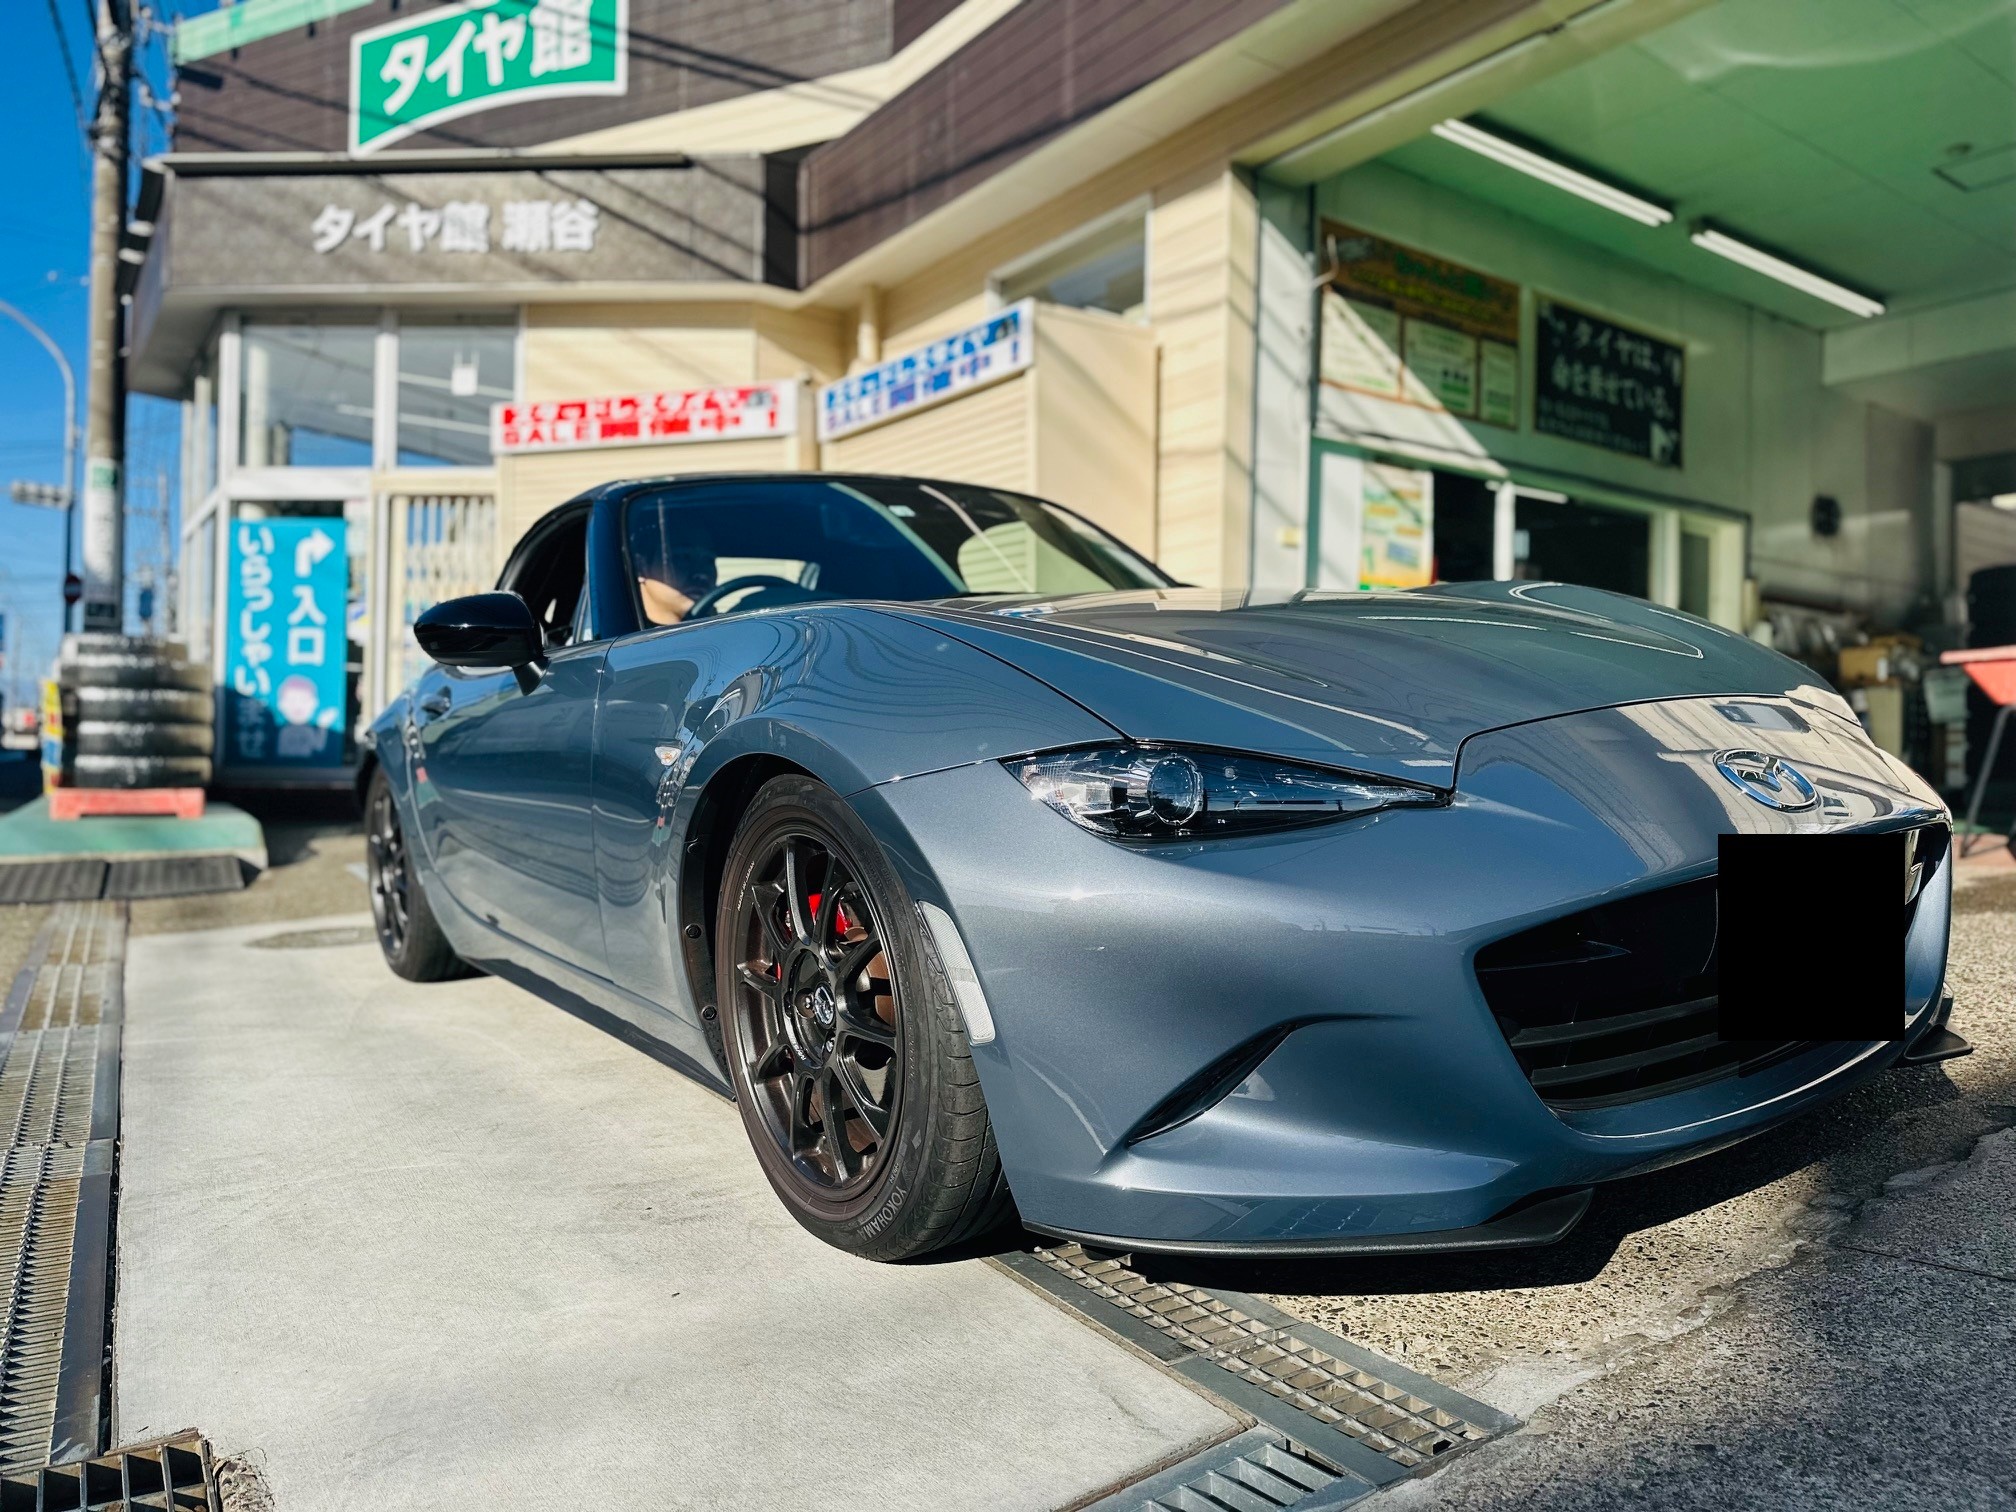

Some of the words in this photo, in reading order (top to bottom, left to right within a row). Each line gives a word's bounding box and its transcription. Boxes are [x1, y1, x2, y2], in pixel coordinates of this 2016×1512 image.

[380, 0, 593, 117] タイヤ館
[310, 202, 490, 254] タイヤ館
[502, 200, 600, 252] 瀬谷
[286, 583, 328, 667] 入口
[856, 1185, 927, 1241] YOKOHAMA
